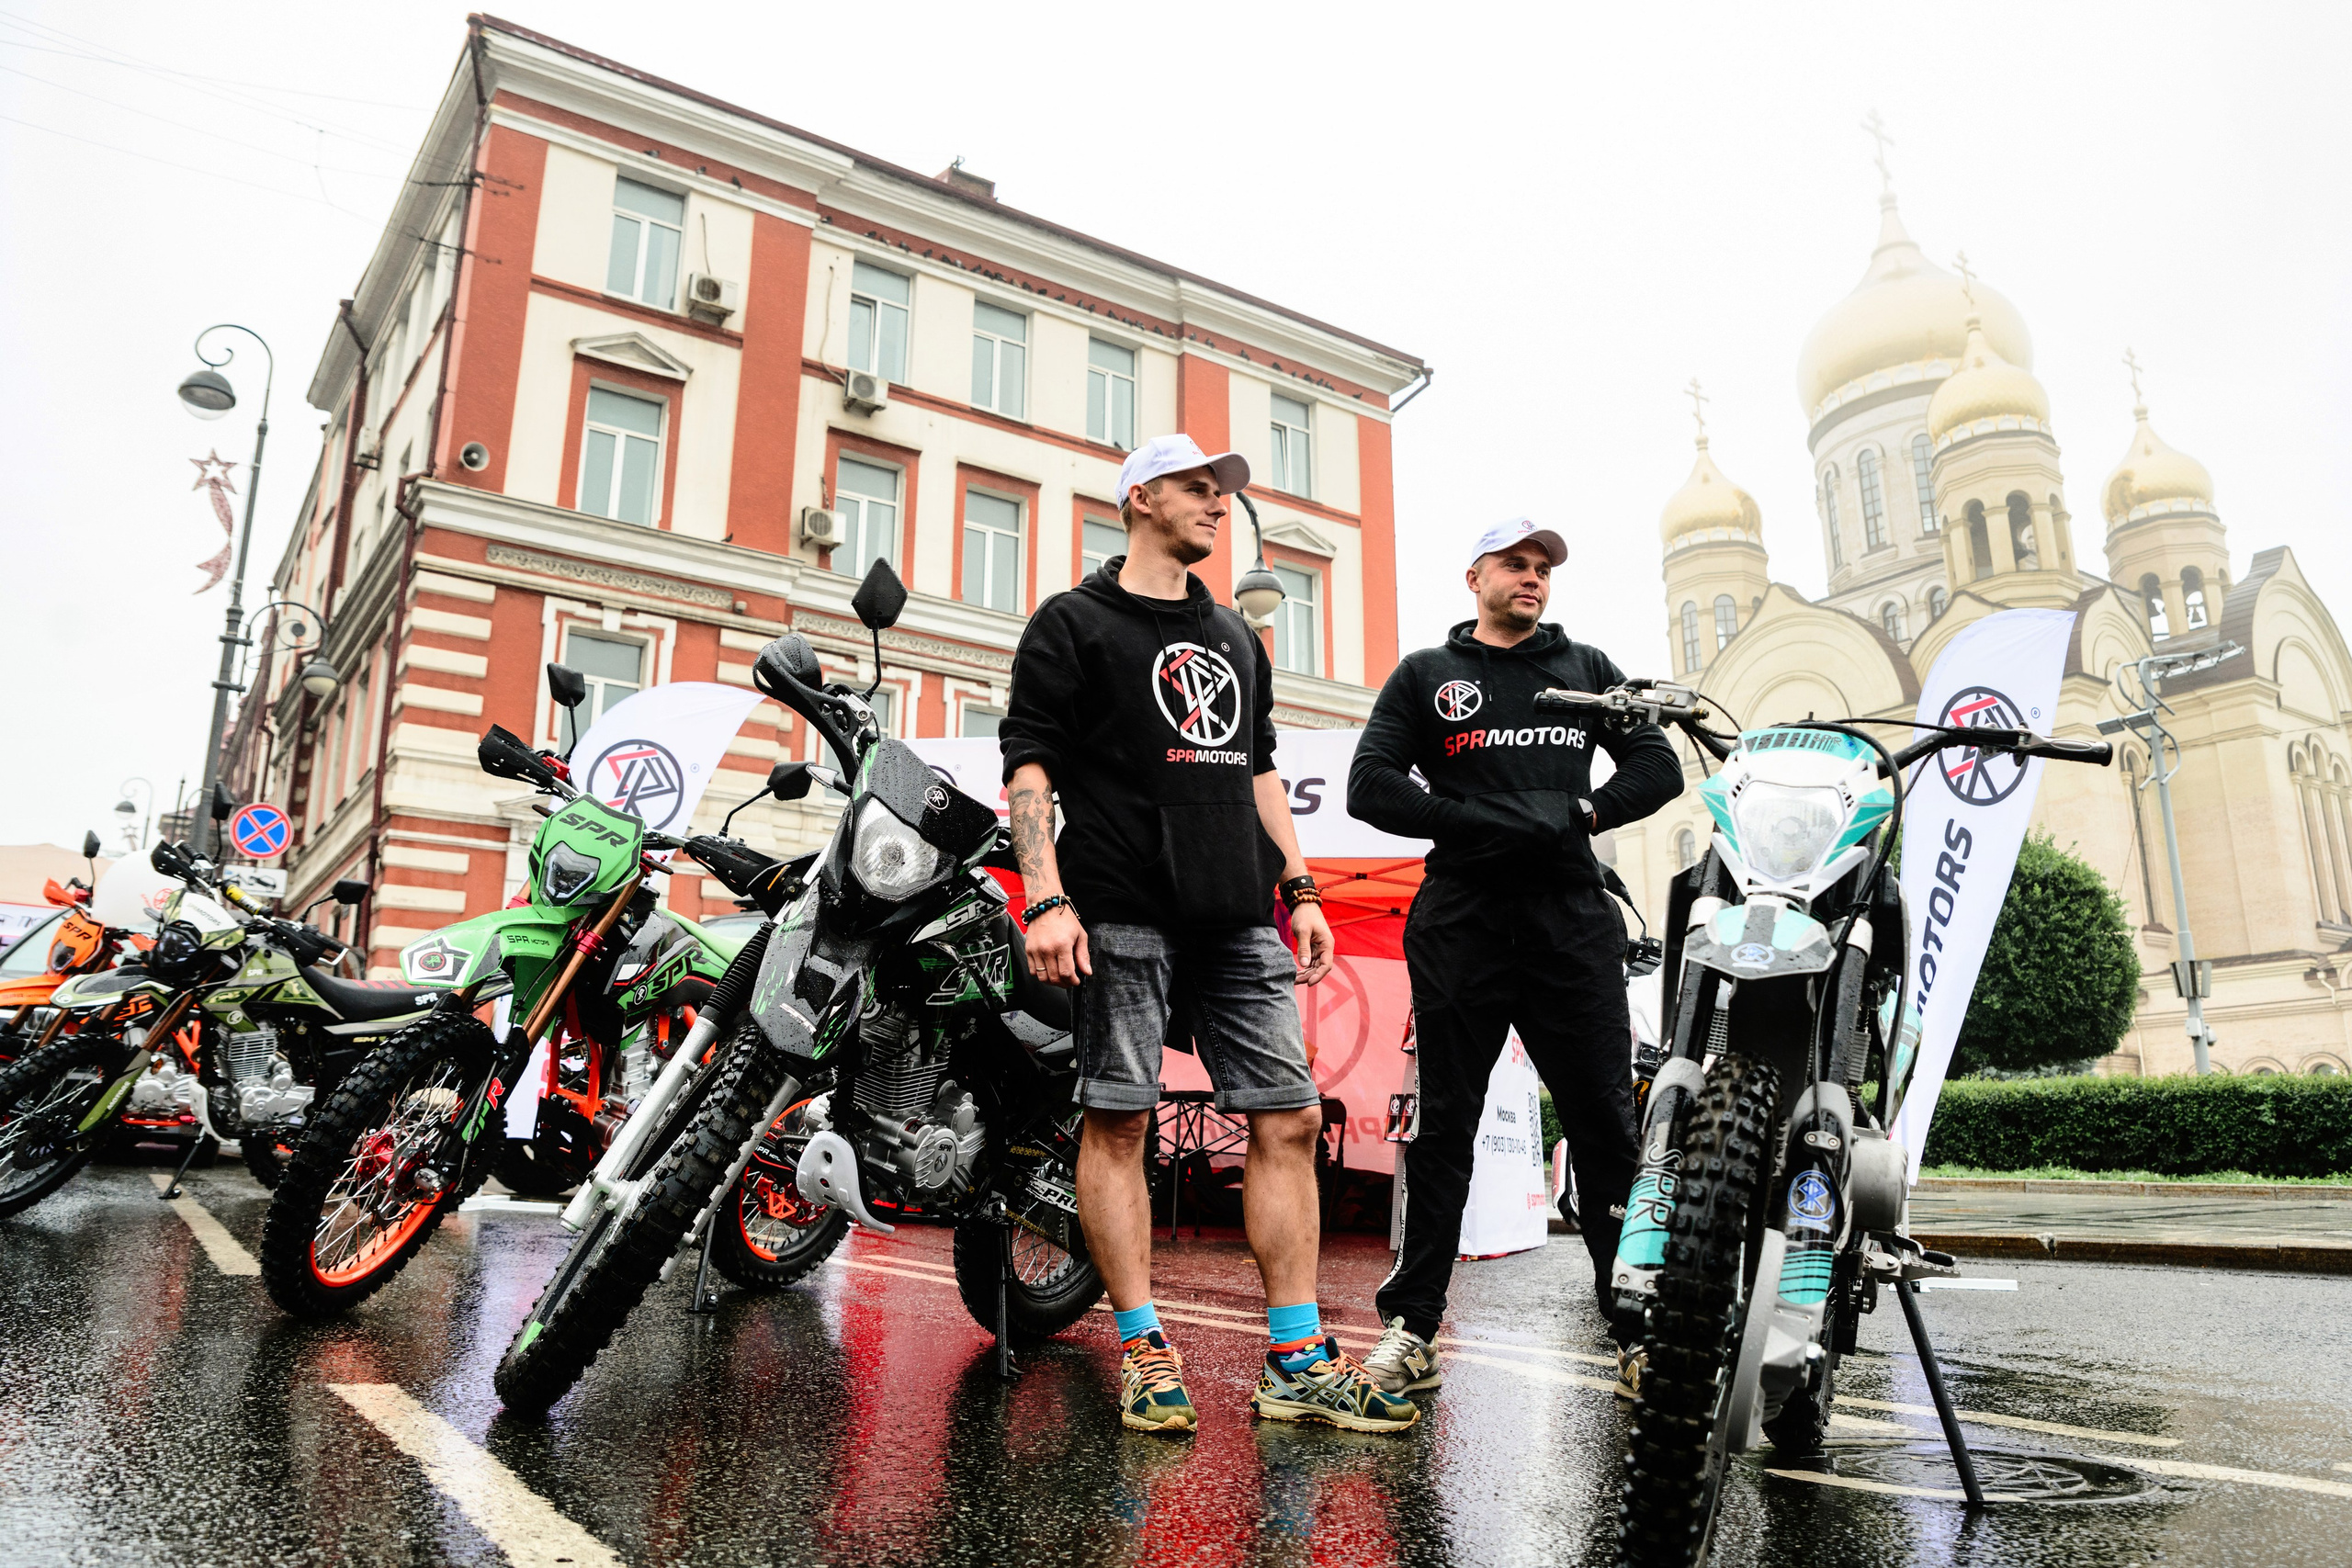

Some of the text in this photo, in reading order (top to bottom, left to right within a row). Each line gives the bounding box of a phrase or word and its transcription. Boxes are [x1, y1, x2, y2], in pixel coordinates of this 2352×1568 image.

[1444, 726, 1587, 757] SPRMOTORS
[1166, 748, 1248, 766] SPRMOTORS
[559, 812, 629, 848] SPR
[63, 921, 93, 941] SPR
[506, 934, 530, 945] SPR
[414, 992, 438, 1006] SPR
[1497, 1105, 1517, 1124] Москва
[938, 1144, 953, 1152] SPR
[1481, 1134, 1490, 1151] +7
[1491, 1135, 1507, 1156] (903)
